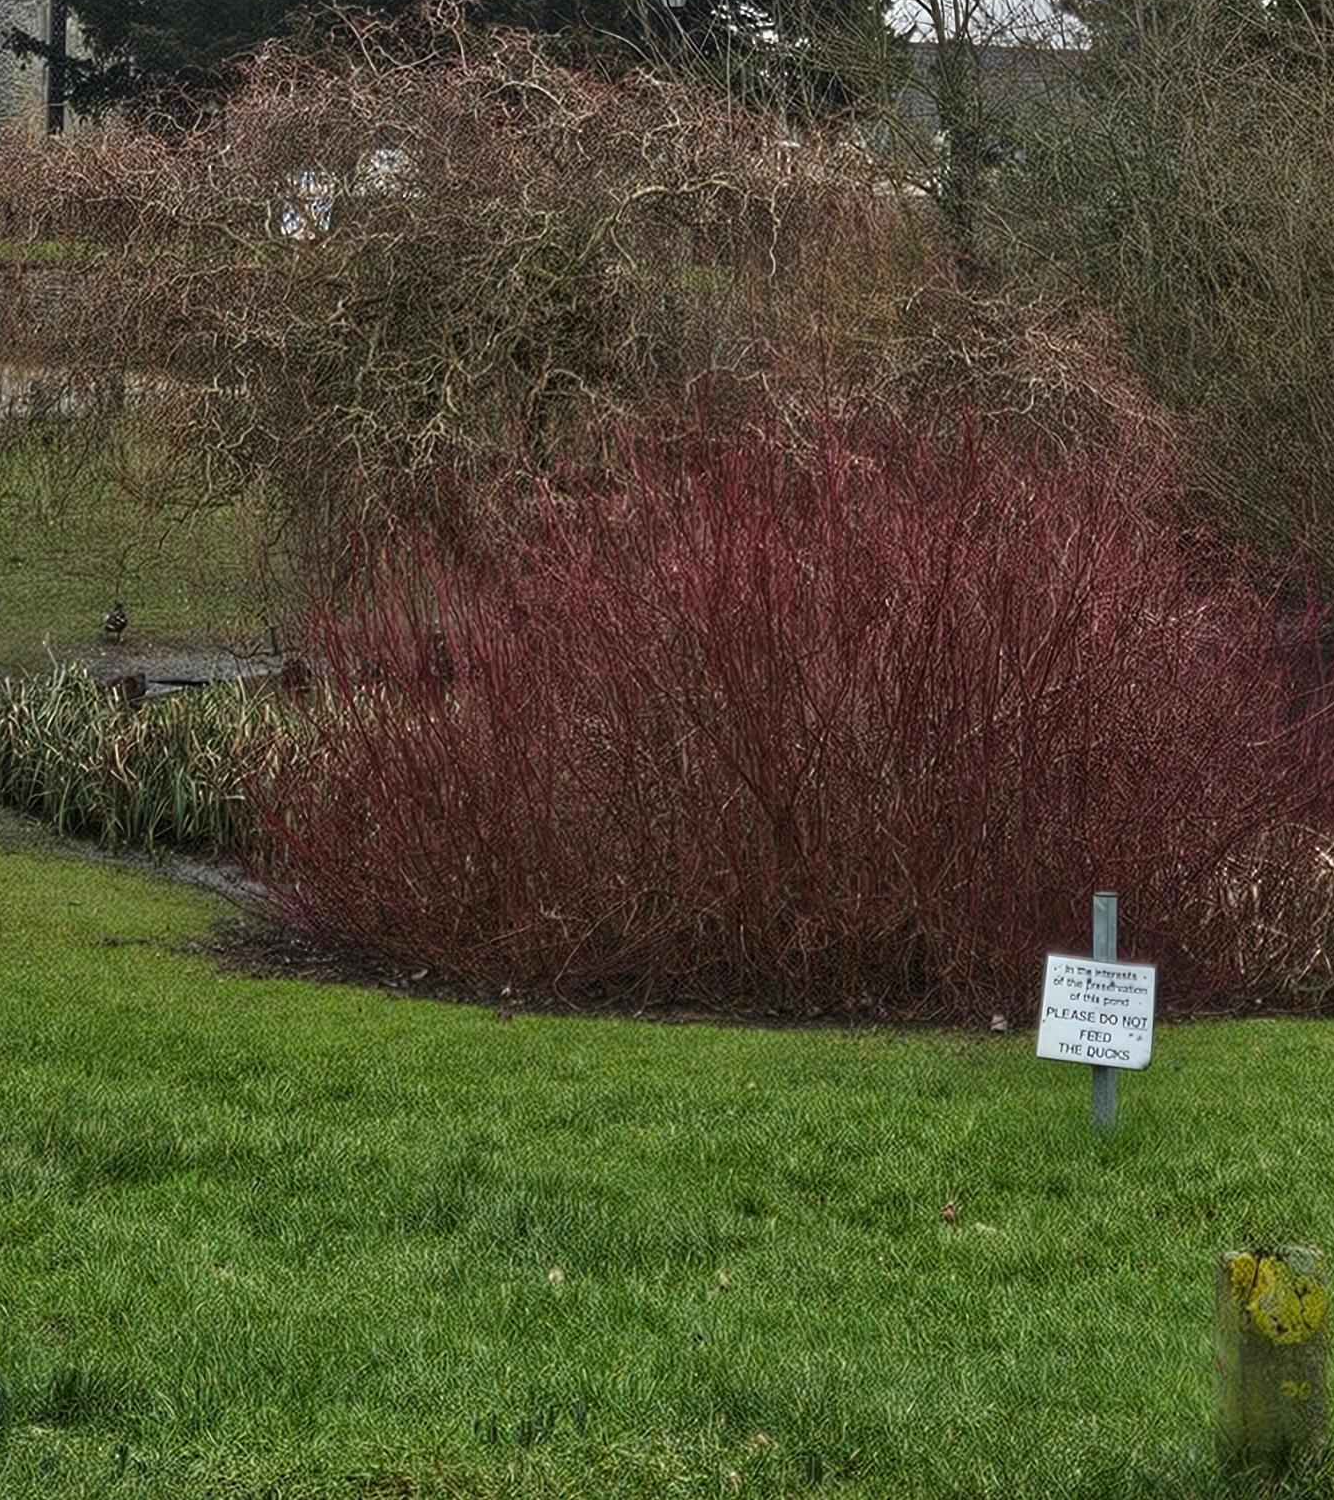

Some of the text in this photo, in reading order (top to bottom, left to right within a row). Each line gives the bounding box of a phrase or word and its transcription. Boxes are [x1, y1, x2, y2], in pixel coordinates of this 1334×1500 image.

[1053, 976, 1064, 986] of
[1066, 978, 1083, 988] the
[1070, 993, 1129, 1007] of this pond
[1047, 1007, 1148, 1029] PLEASE DO NOT
[1079, 1029, 1112, 1043] FEED
[1059, 1042, 1130, 1060] THE DUCKS
